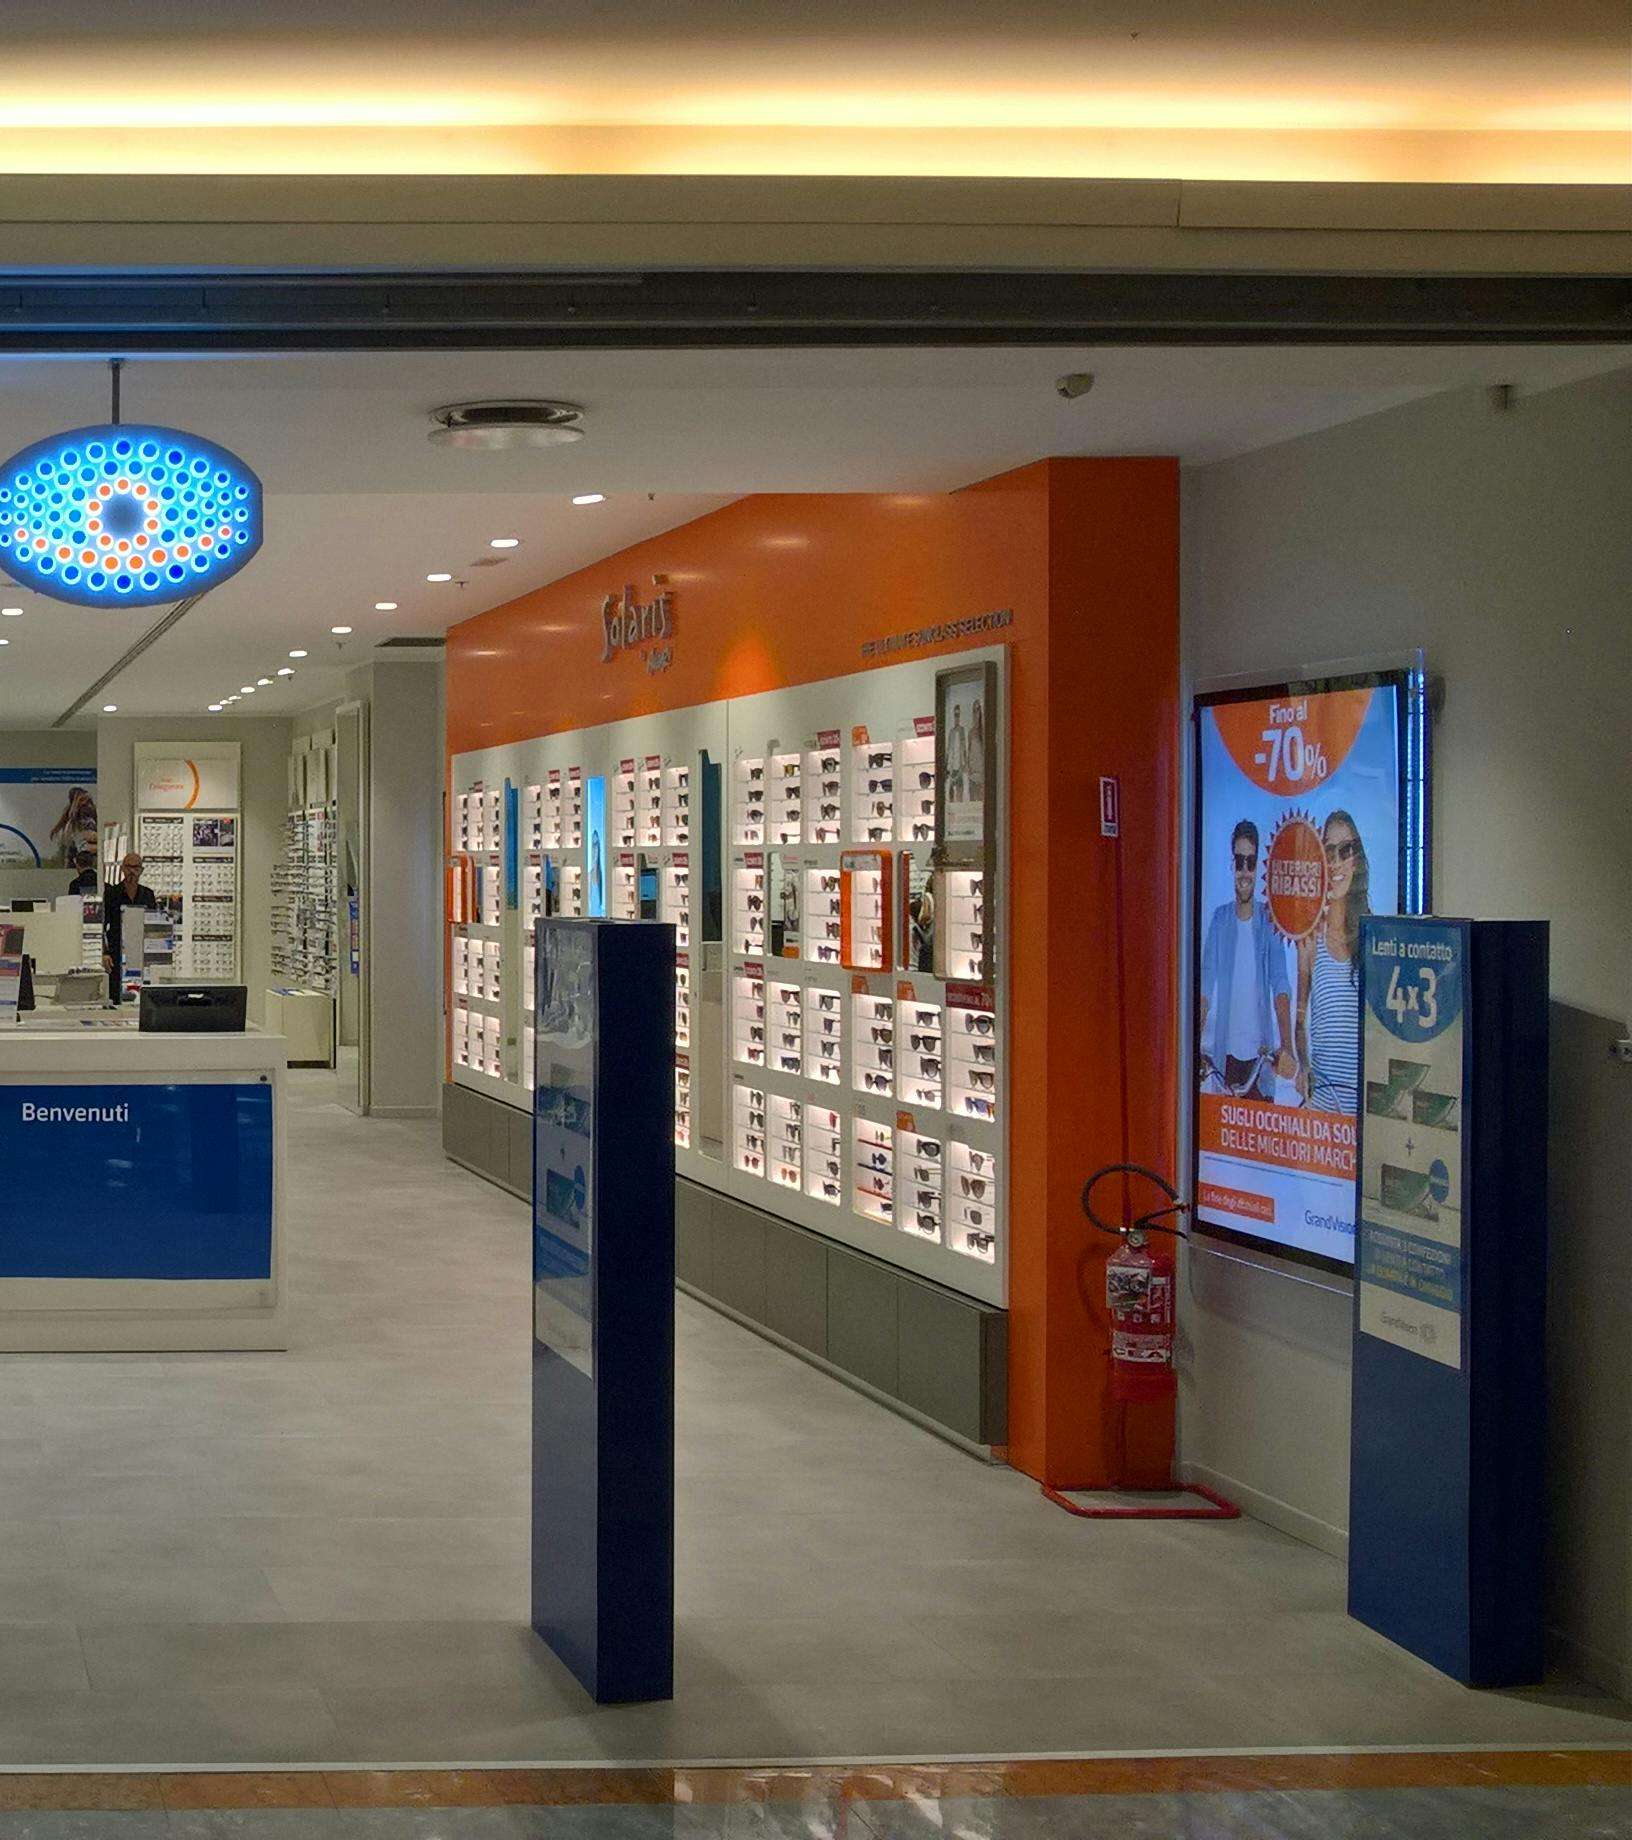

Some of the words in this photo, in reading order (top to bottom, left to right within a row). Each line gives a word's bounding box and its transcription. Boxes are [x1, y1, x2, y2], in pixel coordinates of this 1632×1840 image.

[1269, 703, 1294, 724] Fino
[1295, 701, 1308, 722] al
[1254, 726, 1327, 782] -70%
[1271, 860, 1321, 876] ULTERIORI
[1271, 874, 1321, 897] RIBASSI
[1372, 936, 1397, 956] Lenti
[1399, 943, 1405, 957] a
[1407, 942, 1453, 961] contatto
[1386, 965, 1437, 1028] 4x3
[22, 1102, 129, 1122] Benvenuti
[1221, 1105, 1254, 1129] SUGLI
[1257, 1111, 1311, 1138] OCCHIALI
[1313, 1121, 1331, 1142] DA
[1221, 1128, 1256, 1152] DELLE
[1258, 1136, 1310, 1162] MIGLIORI
